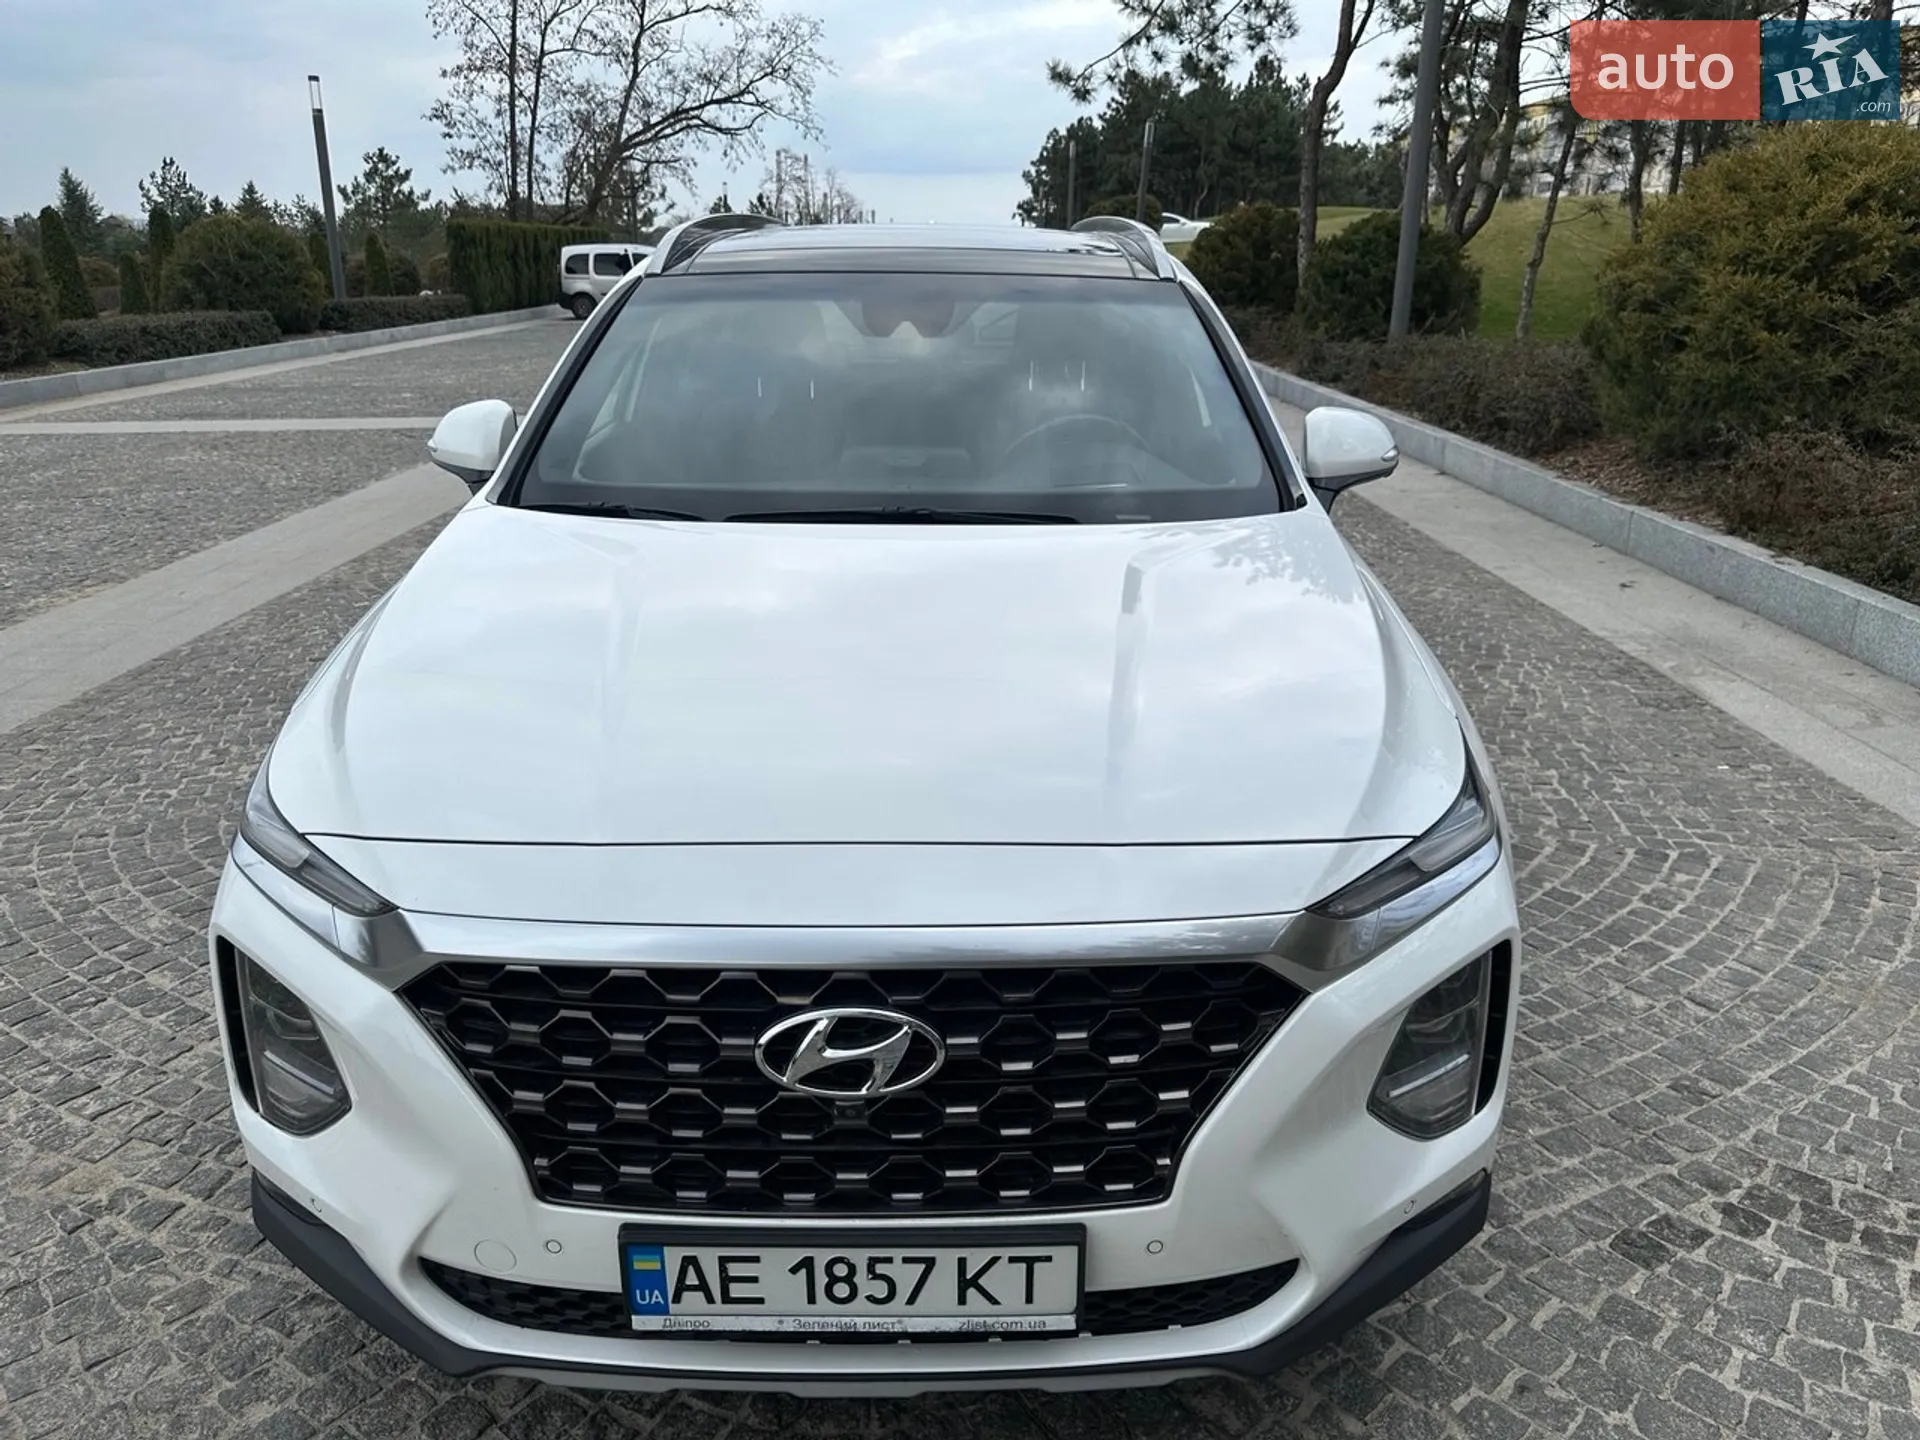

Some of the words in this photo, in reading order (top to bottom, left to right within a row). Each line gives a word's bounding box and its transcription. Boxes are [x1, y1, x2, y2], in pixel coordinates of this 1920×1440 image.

[635, 1289, 665, 1305] UA
[671, 1255, 766, 1305] AE
[787, 1256, 937, 1306] 1857
[957, 1255, 1054, 1306] KT
